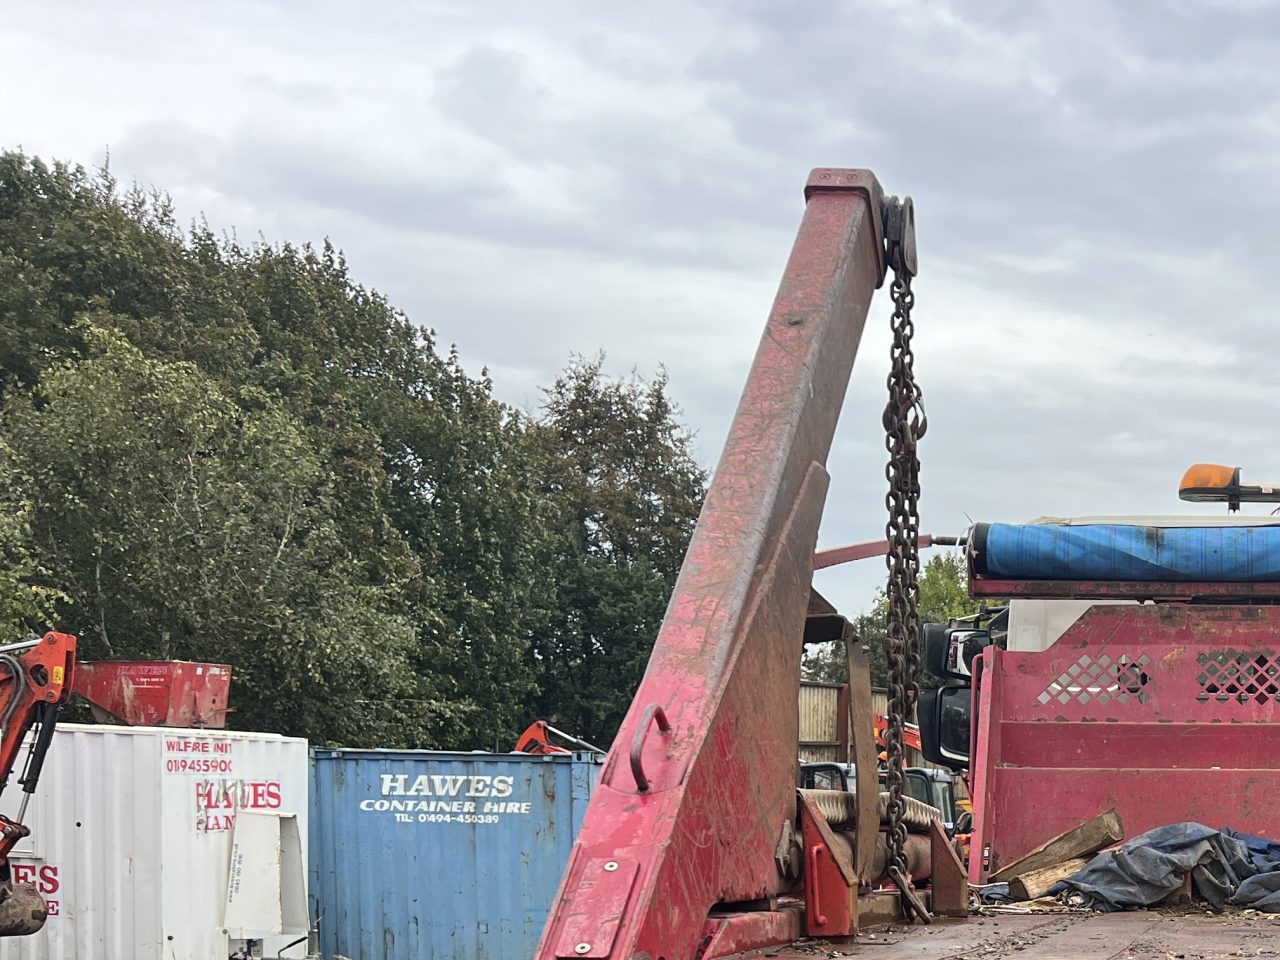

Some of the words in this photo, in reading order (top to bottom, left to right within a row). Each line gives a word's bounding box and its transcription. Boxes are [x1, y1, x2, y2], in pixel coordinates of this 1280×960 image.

[380, 774, 514, 798] HAWES
[359, 799, 476, 813] CONTAINER
[483, 802, 532, 814] HIRE
